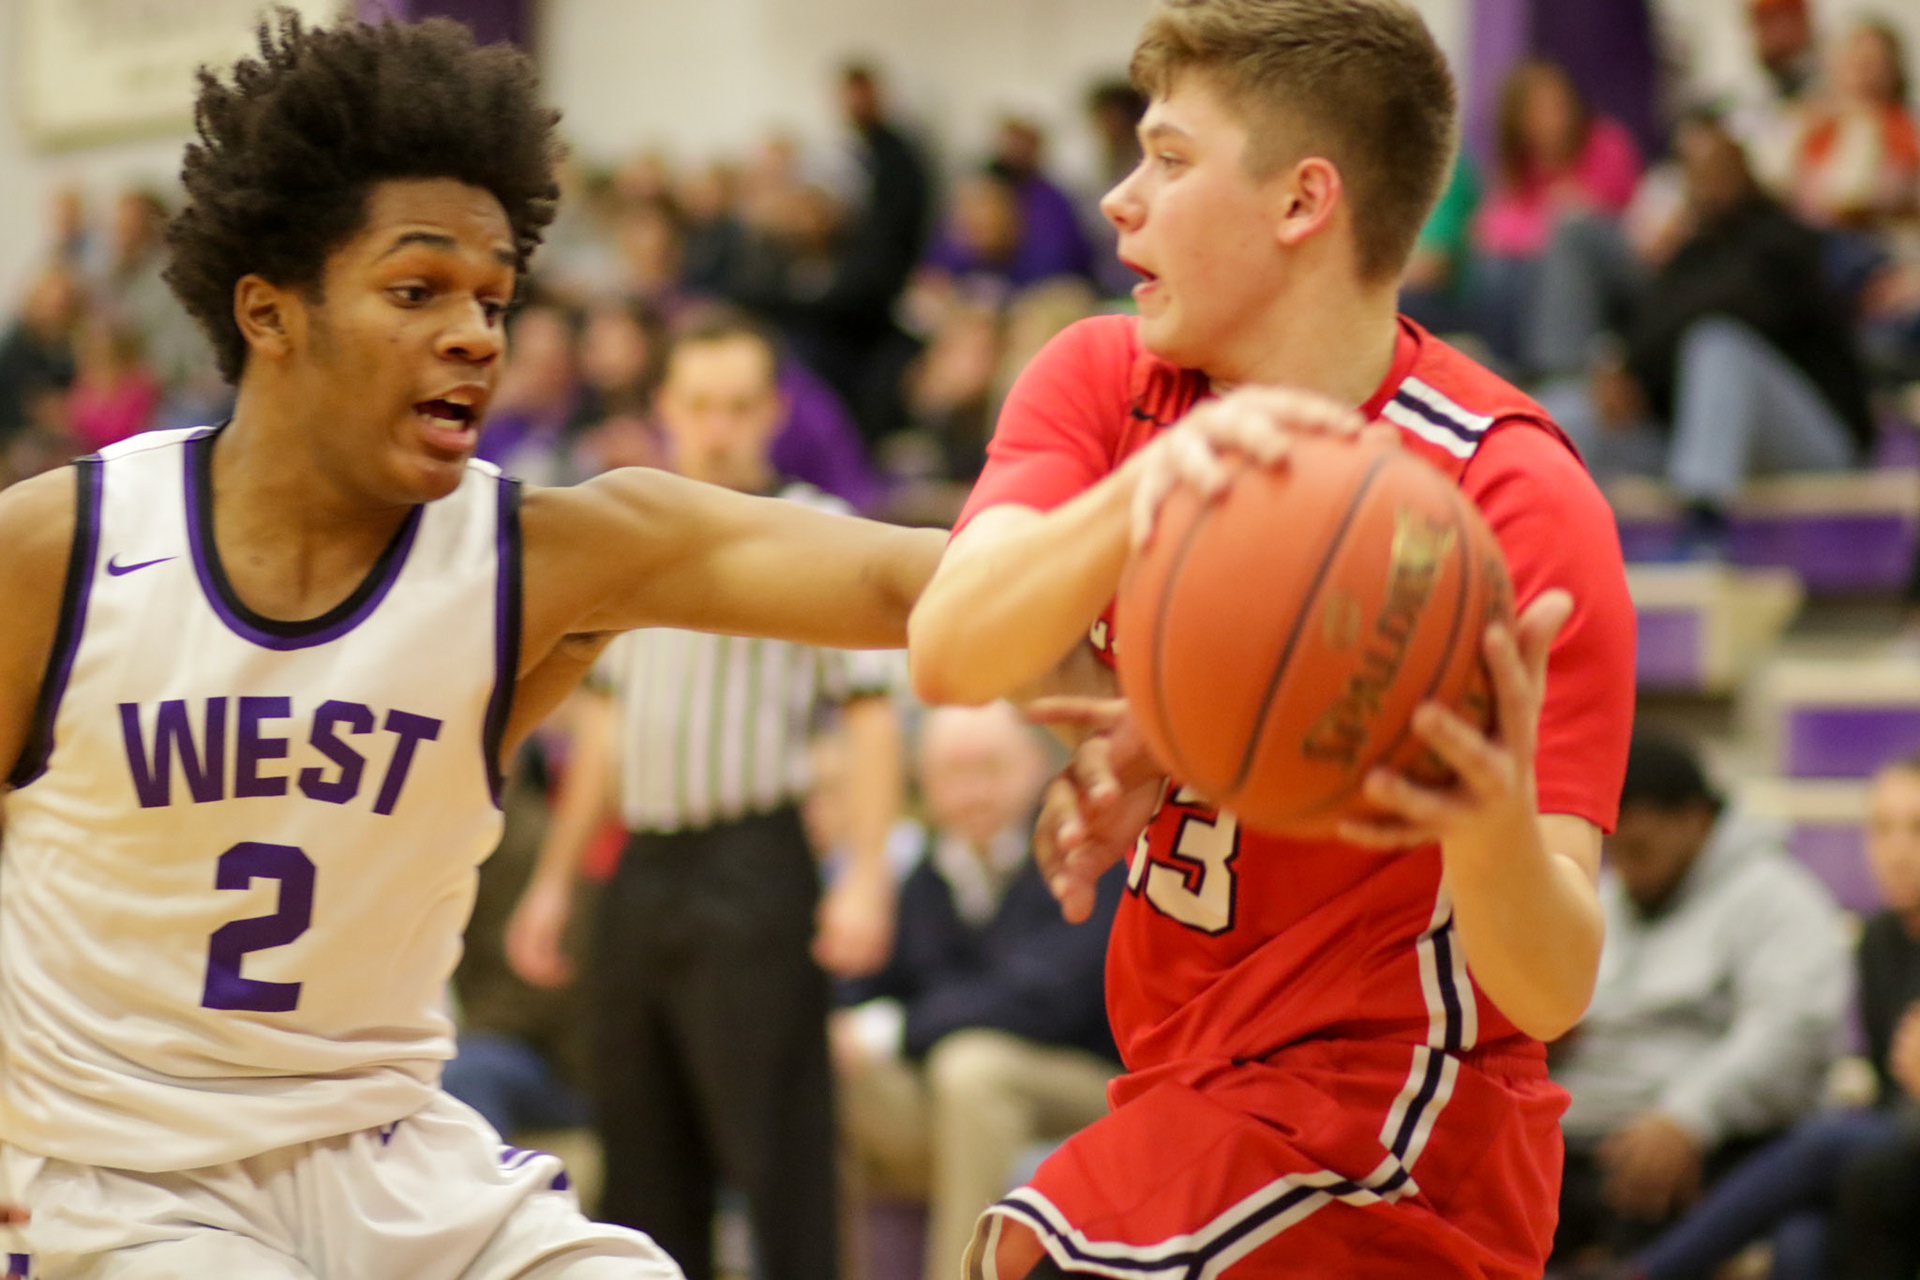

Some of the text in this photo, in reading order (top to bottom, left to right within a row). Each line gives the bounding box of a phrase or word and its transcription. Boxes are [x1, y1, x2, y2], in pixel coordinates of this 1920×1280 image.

[118, 696, 443, 815] WEST
[200, 841, 317, 1012] 2
[1127, 776, 1241, 937] 3
